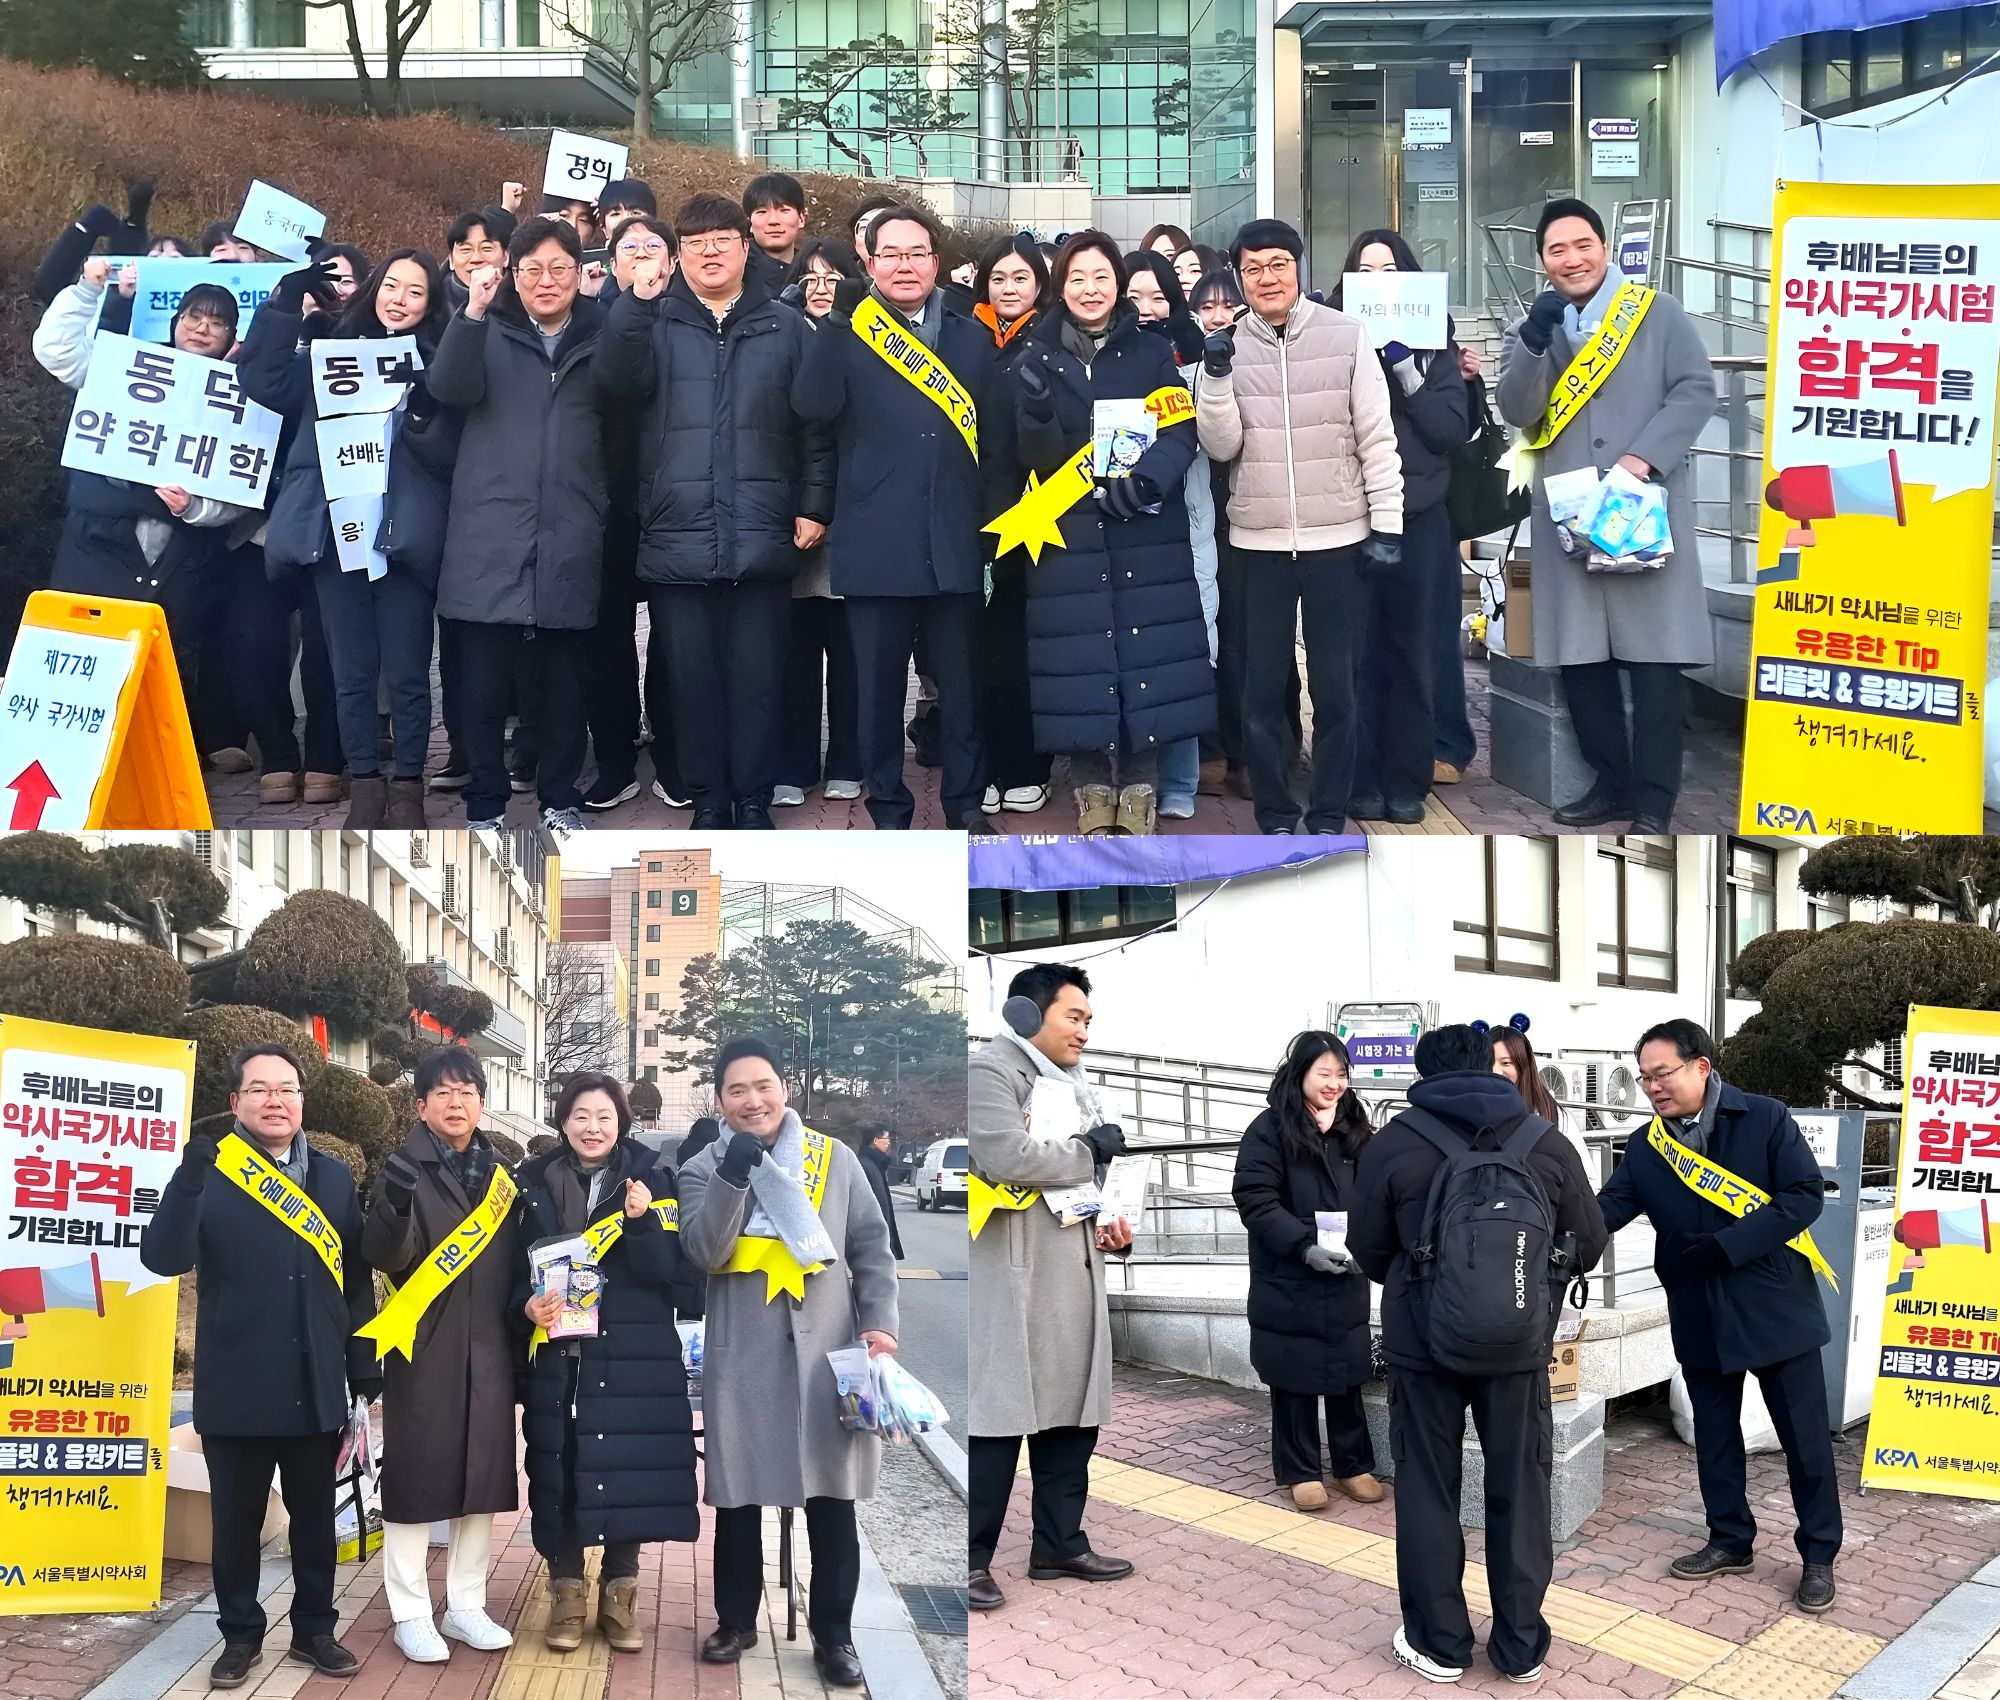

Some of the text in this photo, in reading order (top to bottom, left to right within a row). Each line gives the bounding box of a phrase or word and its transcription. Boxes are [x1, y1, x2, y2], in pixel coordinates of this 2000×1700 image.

[566, 152, 613, 181] 경희
[1806, 241, 1978, 275] 후배님들의
[1786, 278, 1996, 323] 약사국가시험
[868, 315, 978, 445] 서울특별시약
[1792, 406, 1981, 446] 기원합니다!
[74, 409, 269, 490] 약학대학
[341, 521, 364, 542] 응
[1774, 591, 1962, 630] 새내기 약사님을 위한
[44, 649, 97, 681] 제77회
[1795, 629, 1939, 673] 유용한 Tip
[1760, 664, 1831, 701] 리플릿
[1836, 674, 1853, 705] &
[7, 694, 105, 733] 약사 국가시험
[1793, 714, 1927, 763] 챙겨가세요.
[1757, 802, 1817, 834] KPA
[678, 894, 691, 912] 9
[1355, 1044, 1415, 1057] 시험장 가는 길
[22, 1072, 163, 1112] 후배님들의
[3, 1103, 176, 1152] 약사국가시험
[434, 1220, 488, 1276] 기원
[1515, 1231, 1527, 1309] new balance
[1894, 1299, 1999, 1321] 새내기 약사님을
[1907, 1325, 2000, 1354] 유용한 Ti
[1883, 1351, 1932, 1376] 리플릿
[1936, 1355, 1949, 1377] &
[49, 1379, 114, 1399] 약사님을
[120, 1384, 148, 1399] 위한
[1904, 1385, 1999, 1416] 챙겨가세요.
[8, 1409, 130, 1437] 유용한 Tip
[44, 1443, 59, 1470] &
[1875, 1448, 2000, 1475] KPA 서울특별시약
[6, 1483, 119, 1510] 챙겨가세요.
[33, 1565, 146, 1582] 서울특별시약사회
